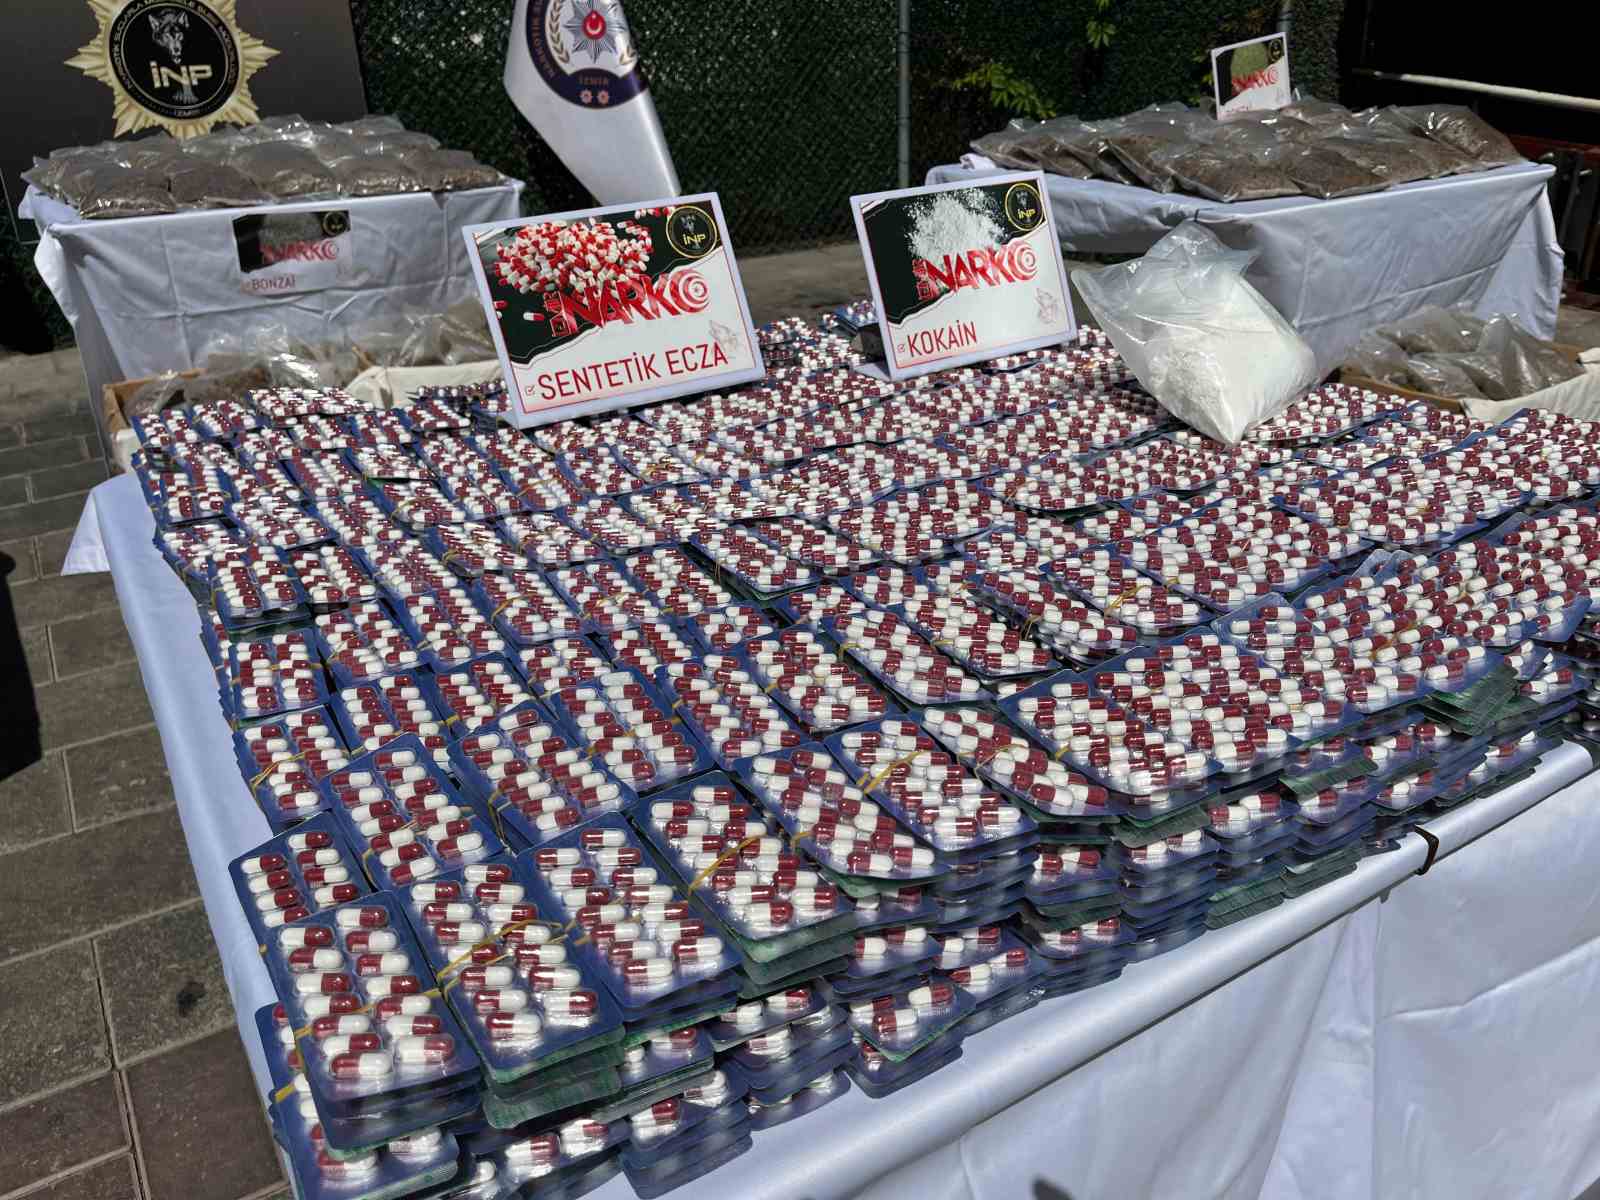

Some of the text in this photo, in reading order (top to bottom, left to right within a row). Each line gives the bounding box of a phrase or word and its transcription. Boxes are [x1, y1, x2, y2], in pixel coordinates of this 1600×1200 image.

[906, 319, 978, 358] KOKAİN
[537, 341, 729, 401] SENTETİK ECZA
